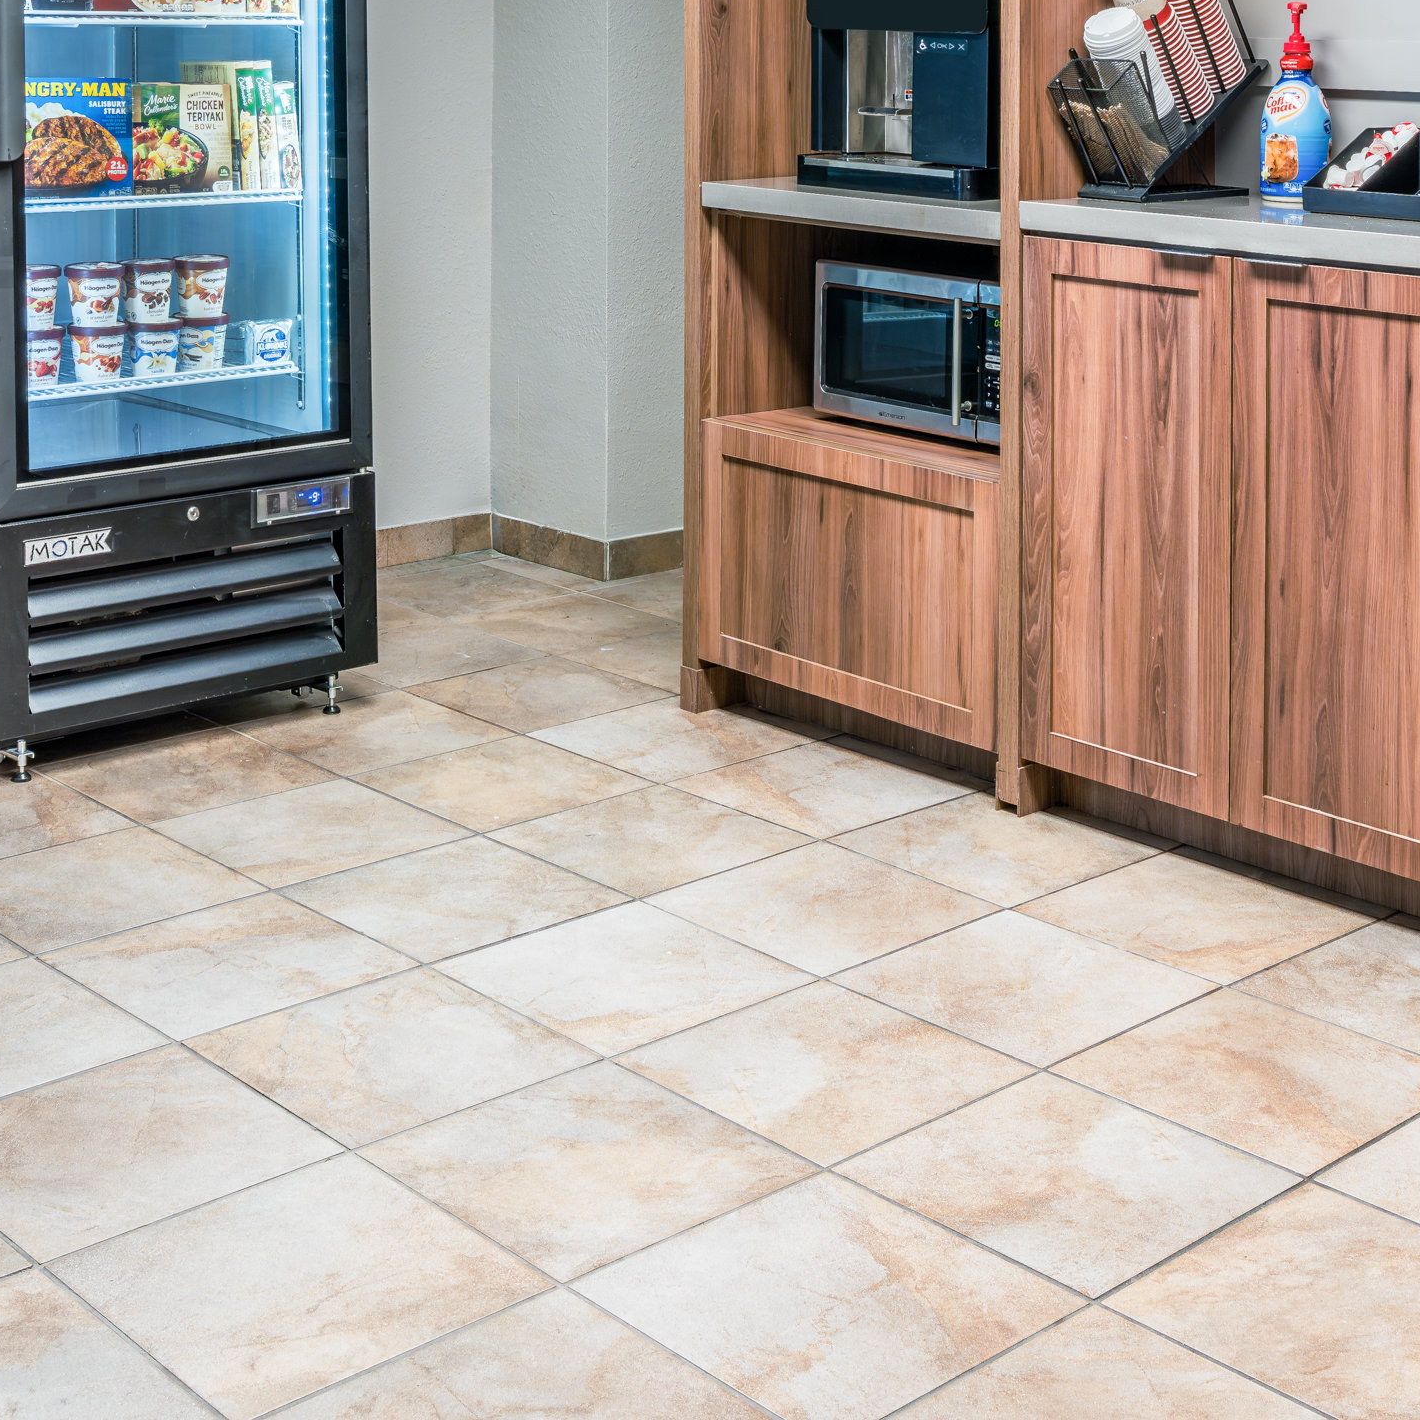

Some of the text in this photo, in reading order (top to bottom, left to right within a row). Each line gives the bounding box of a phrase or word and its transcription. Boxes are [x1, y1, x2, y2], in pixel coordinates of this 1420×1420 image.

[25, 82, 126, 97] NGRY-MAN
[88, 100, 127, 108] SALISBURY
[146, 94, 176, 107] Marie
[186, 100, 224, 111] CHICKEN
[103, 107, 127, 115] STEAK
[186, 111, 224, 122] TERIYAKI
[194, 123, 217, 131] BOWL
[30, 533, 107, 561] MOTAK
